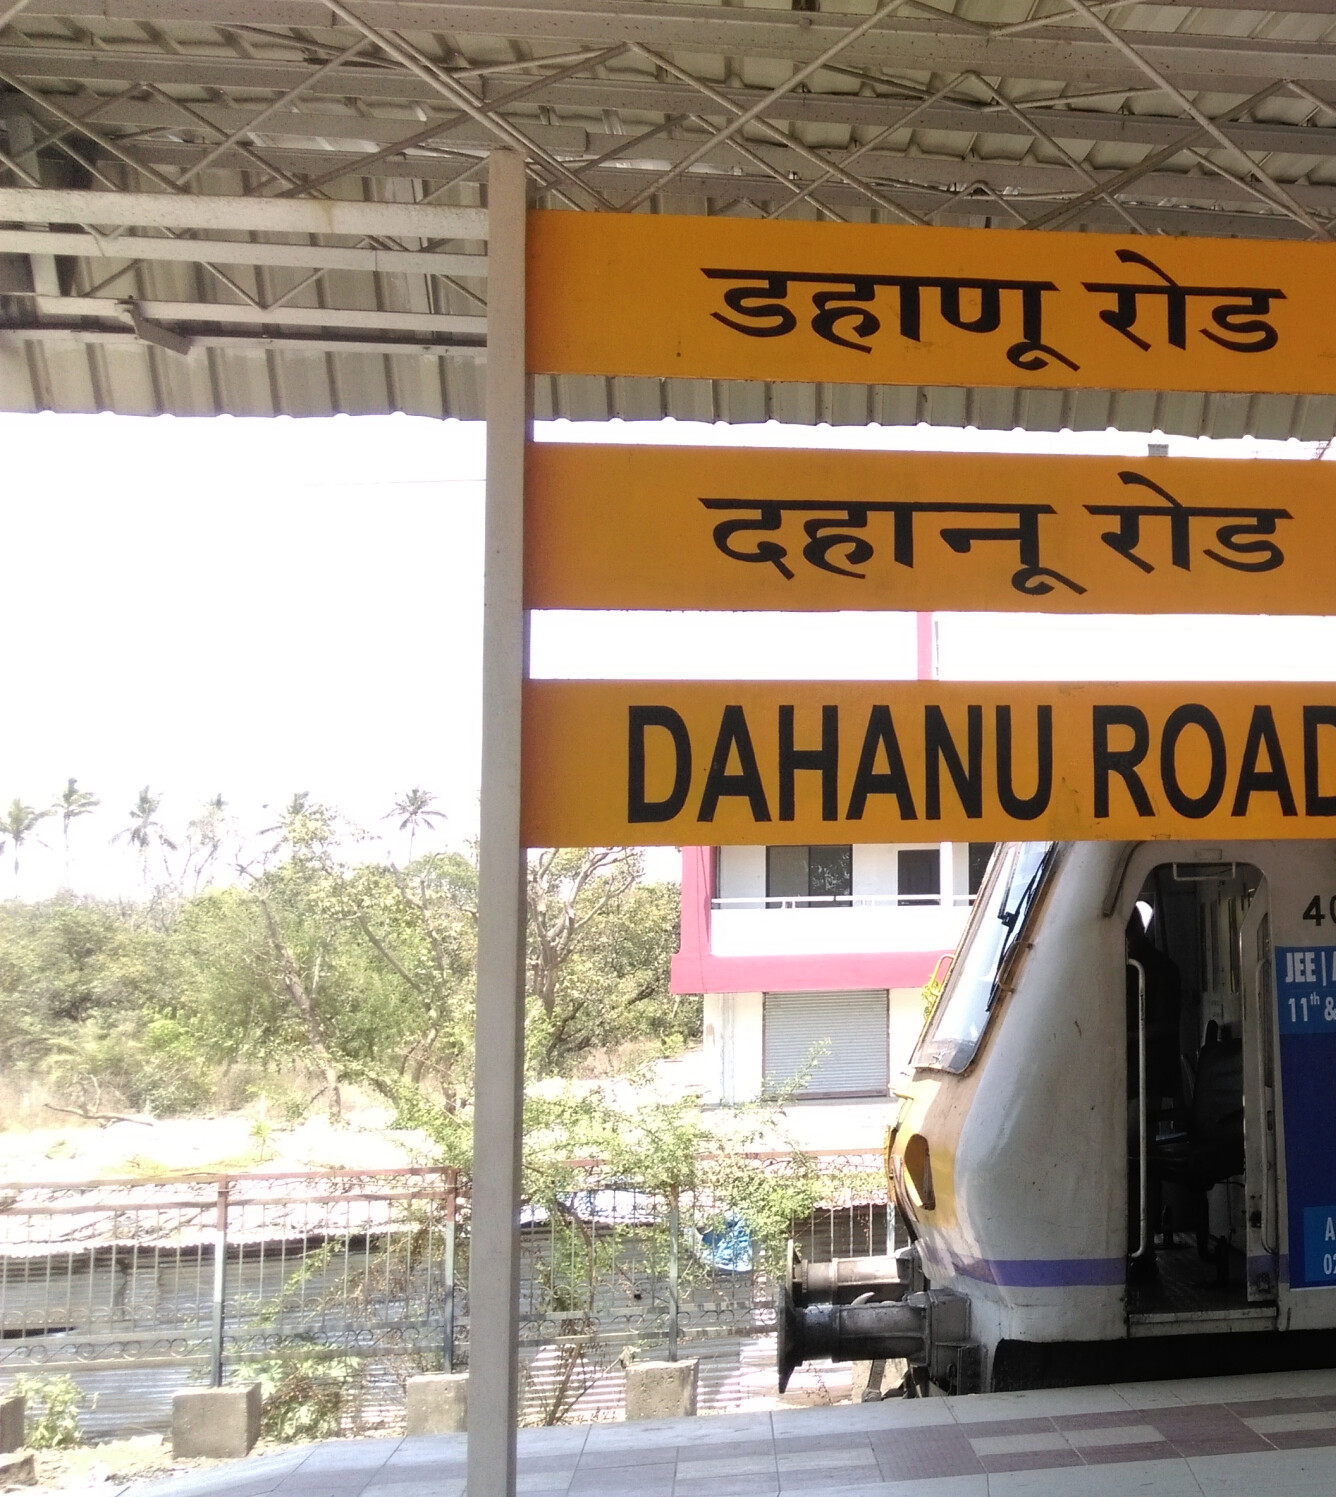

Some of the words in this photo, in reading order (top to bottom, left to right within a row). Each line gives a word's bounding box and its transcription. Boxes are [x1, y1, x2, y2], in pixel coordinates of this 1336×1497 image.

[701, 267, 1081, 372] डहाणू
[1081, 249, 1287, 353] रोड
[698, 497, 1087, 596] दहानू
[1082, 470, 1295, 575] रोड
[627, 704, 1055, 824] DAHANU
[1285, 951, 1316, 982] JEE
